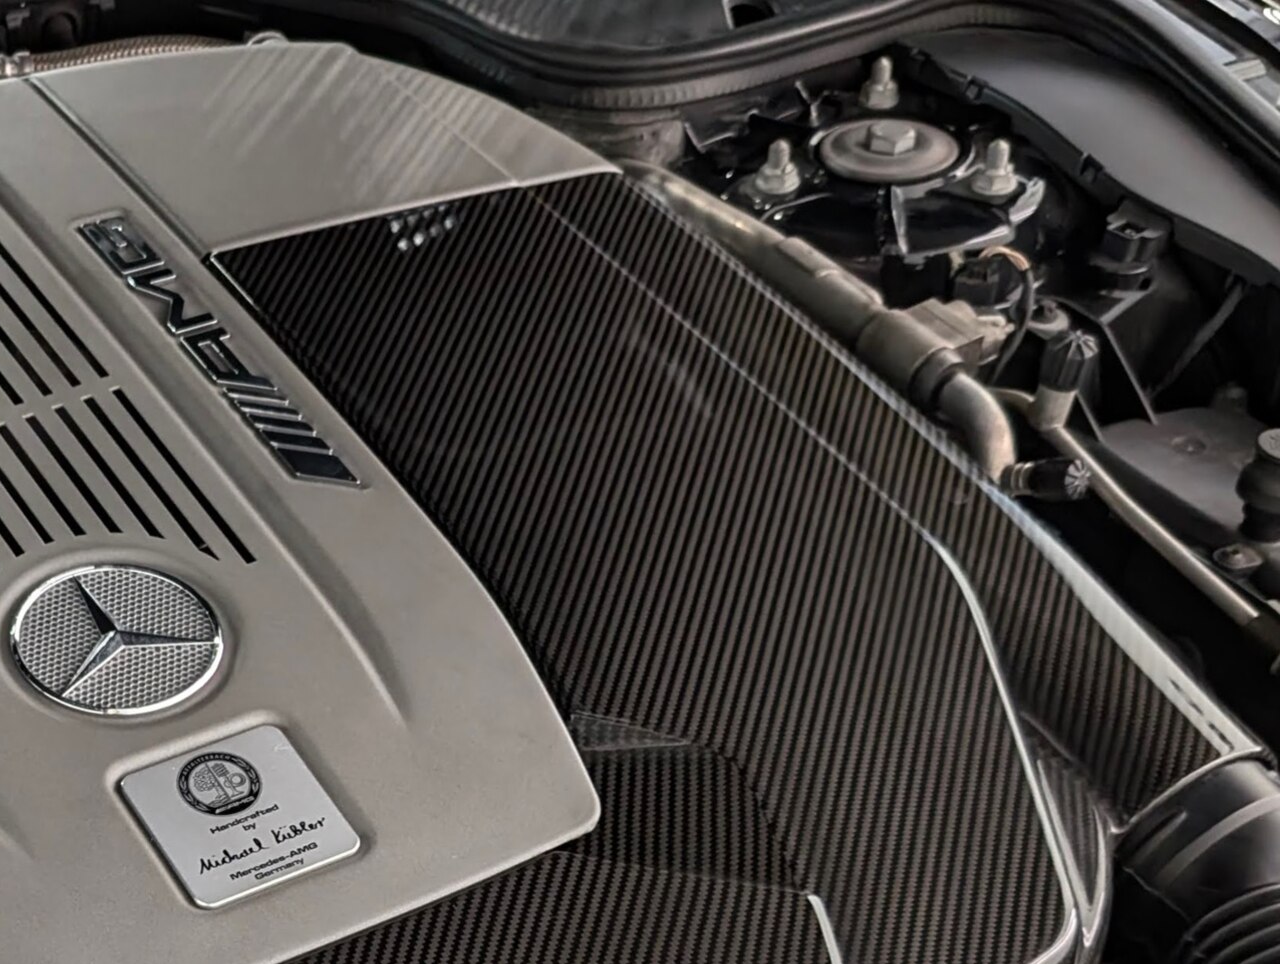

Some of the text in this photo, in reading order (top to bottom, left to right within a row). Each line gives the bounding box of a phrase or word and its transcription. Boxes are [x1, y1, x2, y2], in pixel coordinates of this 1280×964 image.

[210, 804, 279, 834] Handcrafted
[242, 823, 256, 831] by
[200, 838, 270, 875] Michael
[229, 842, 318, 880] Mercedes-AMG
[254, 858, 304, 880] Germany
